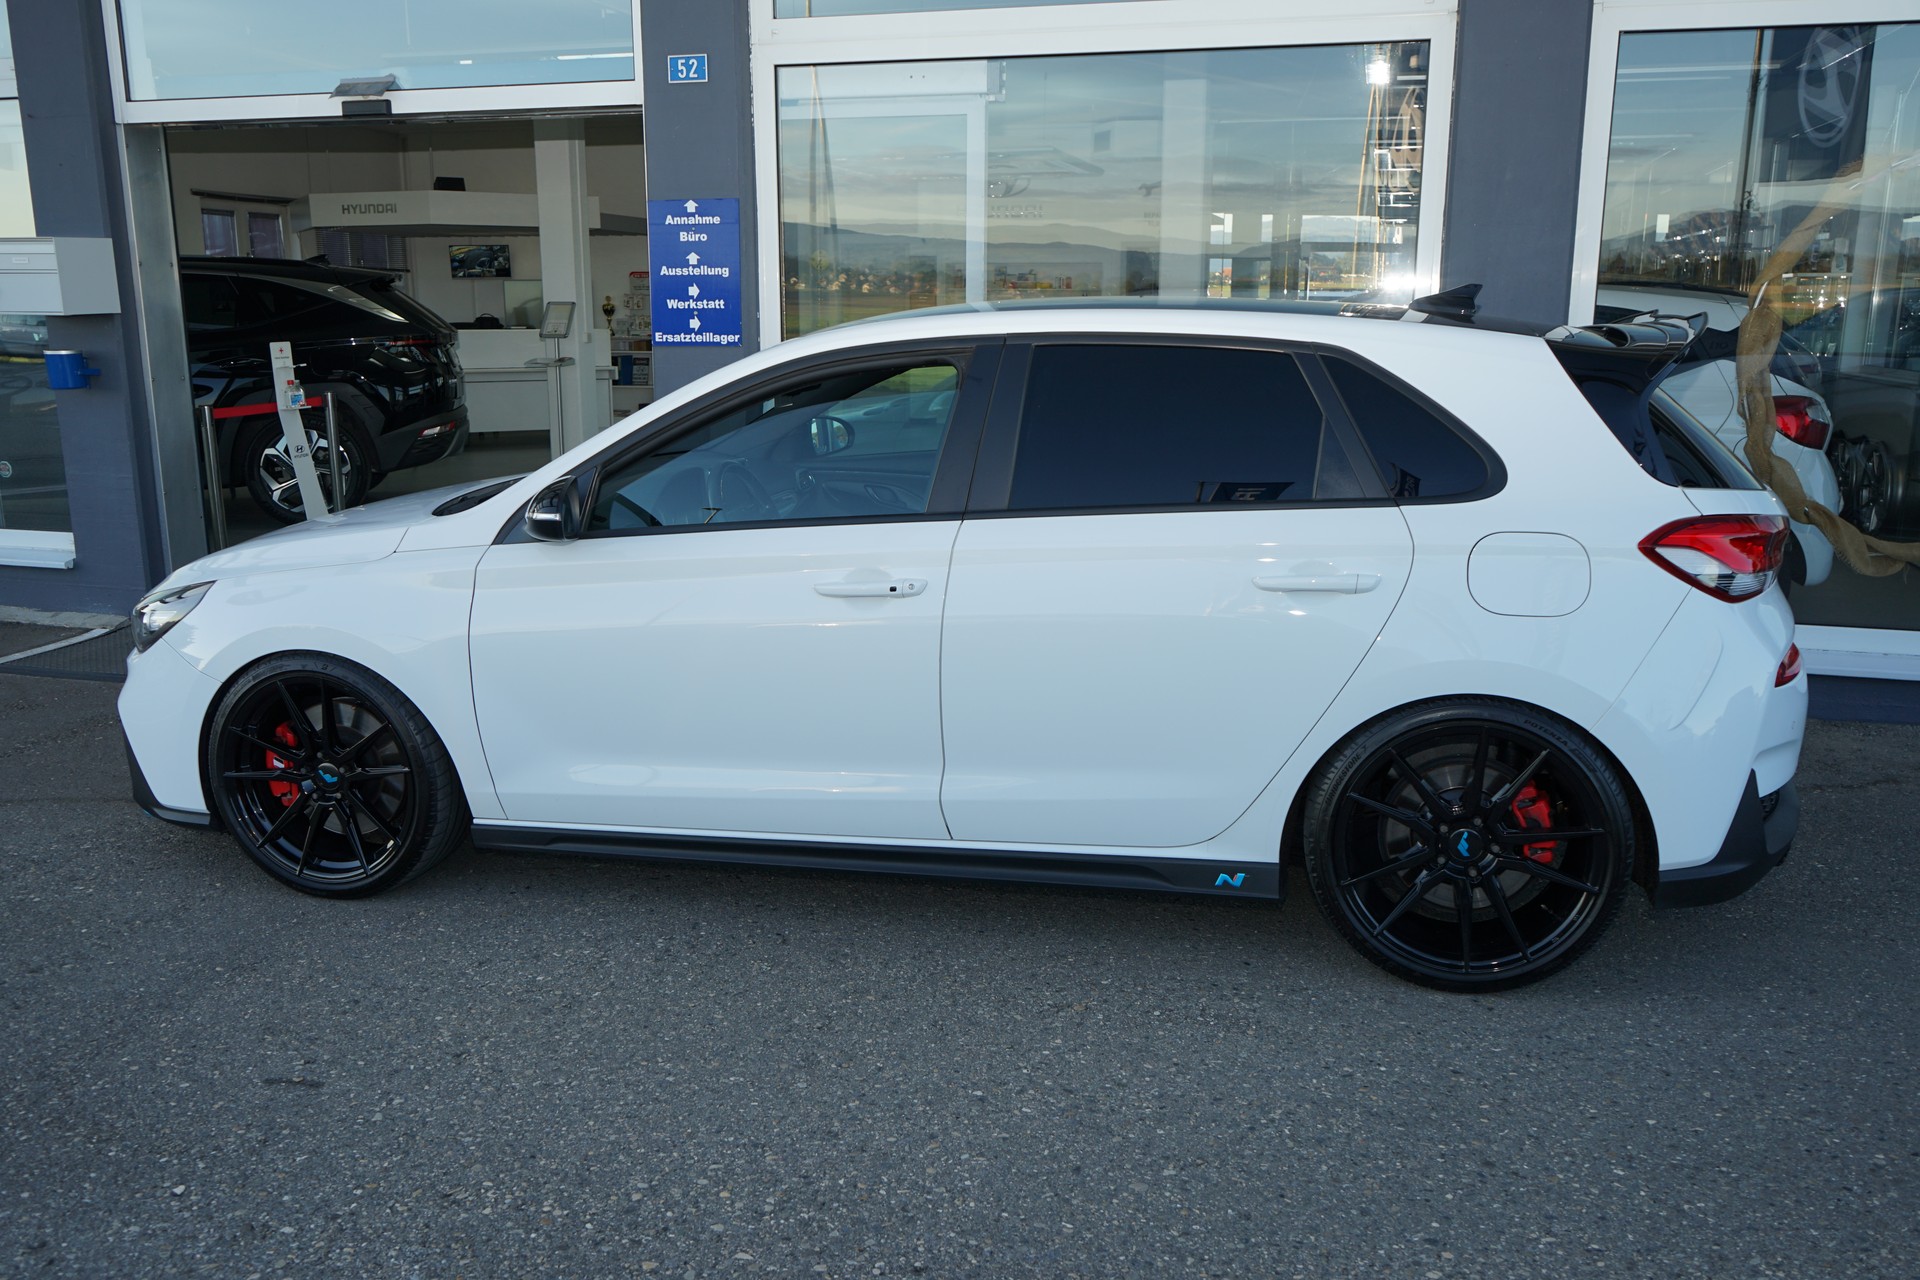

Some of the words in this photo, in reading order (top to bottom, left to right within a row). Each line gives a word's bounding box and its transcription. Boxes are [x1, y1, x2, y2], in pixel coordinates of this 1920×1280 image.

[677, 59, 698, 78] 52
[341, 203, 397, 215] HYUNDAI
[665, 214, 721, 225] Annahme
[679, 231, 708, 242] Büro
[660, 265, 730, 277] Ausstellung
[666, 299, 725, 310] Werkstatt
[655, 332, 740, 344] Ersatzteillager
